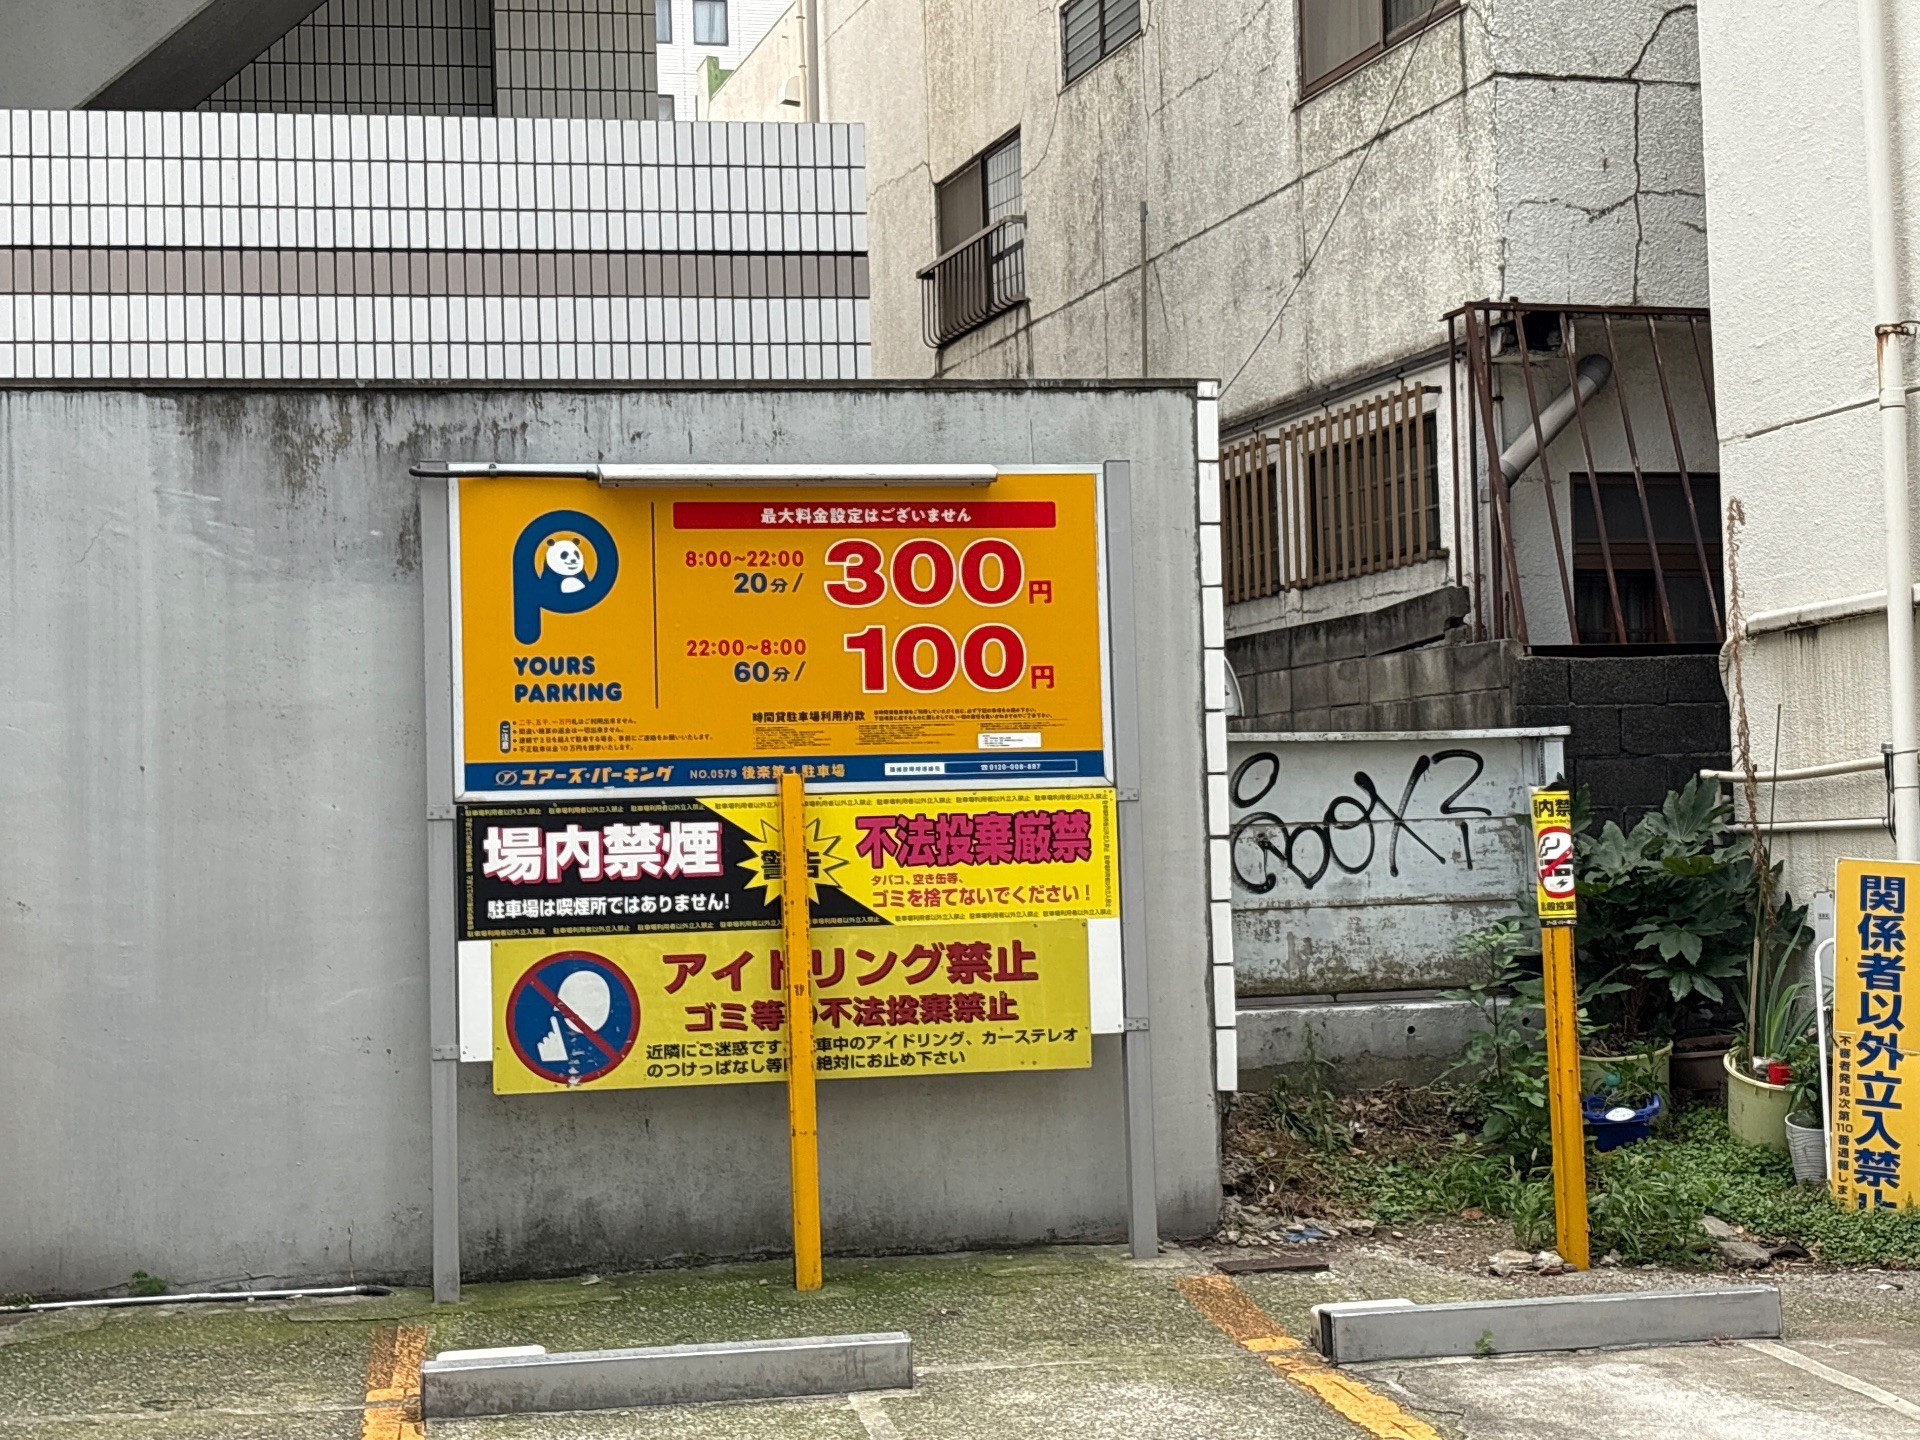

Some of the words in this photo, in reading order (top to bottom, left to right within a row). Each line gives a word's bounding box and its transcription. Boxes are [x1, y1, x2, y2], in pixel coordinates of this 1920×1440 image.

[761, 508, 972, 525] 最大料金設定はございません
[822, 538, 1053, 609] 300円
[513, 656, 596, 677] YOURS
[843, 622, 1055, 694] 100円
[513, 682, 623, 703] PARKING
[752, 710, 866, 723] 時間貸駐車場利用約款
[520, 765, 674, 785] ユアーズ・パーキング
[690, 769, 737, 779] NO.0579
[855, 809, 1092, 869] 不法投棄厳禁
[482, 821, 724, 886] 場内禁煙
[872, 873, 964, 886] タバコ、空き缶等、
[684, 991, 1020, 1032] ゴミ等不法投棄禁止
